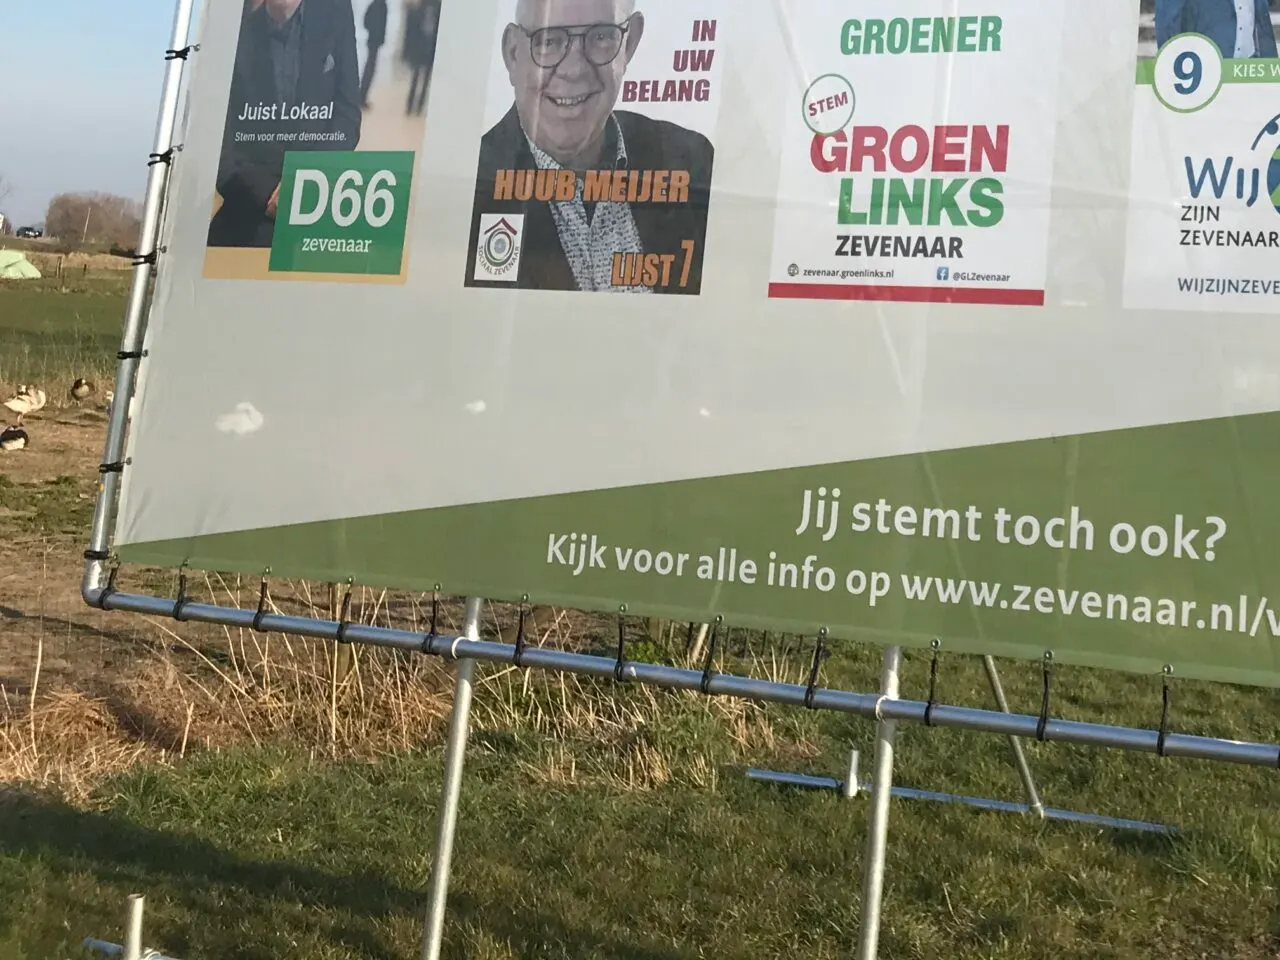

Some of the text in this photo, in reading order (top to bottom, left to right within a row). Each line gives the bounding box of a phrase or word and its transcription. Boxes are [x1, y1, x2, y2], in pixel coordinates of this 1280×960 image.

[692, 20, 717, 42] IN
[840, 16, 1002, 55] GROENER
[672, 49, 714, 72] UW
[1233, 64, 1265, 78] KIES
[1173, 51, 1203, 95] 9
[622, 79, 710, 102] BELANG
[238, 102, 333, 121] Juist Lokaal
[808, 91, 848, 117] STEM
[235, 130, 347, 142] Stem voor meer democratie.
[810, 124, 1010, 173] GROEN
[493, 169, 690, 203] HUUB MEIJER
[288, 169, 397, 228] D66
[837, 177, 1005, 228] LINKS
[1180, 205, 1220, 224] ZIJN
[302, 237, 372, 253] zevenaar
[834, 235, 964, 258] ZEVENAAR
[1179, 230, 1280, 248] ZEVENAAR
[478, 245, 519, 274] SOCIAAL ZEVENAAR
[611, 240, 694, 287] LIJST 7
[803, 268, 1011, 283] zevenaar.groenlinks.nl @GLZevenaar
[796, 487, 1227, 561] Jij stemt toch ook?
[546, 532, 606, 575] Kijk
[615, 546, 690, 576] voor
[696, 547, 757, 584] alle
[767, 552, 836, 592] info
[846, 569, 891, 607] op
